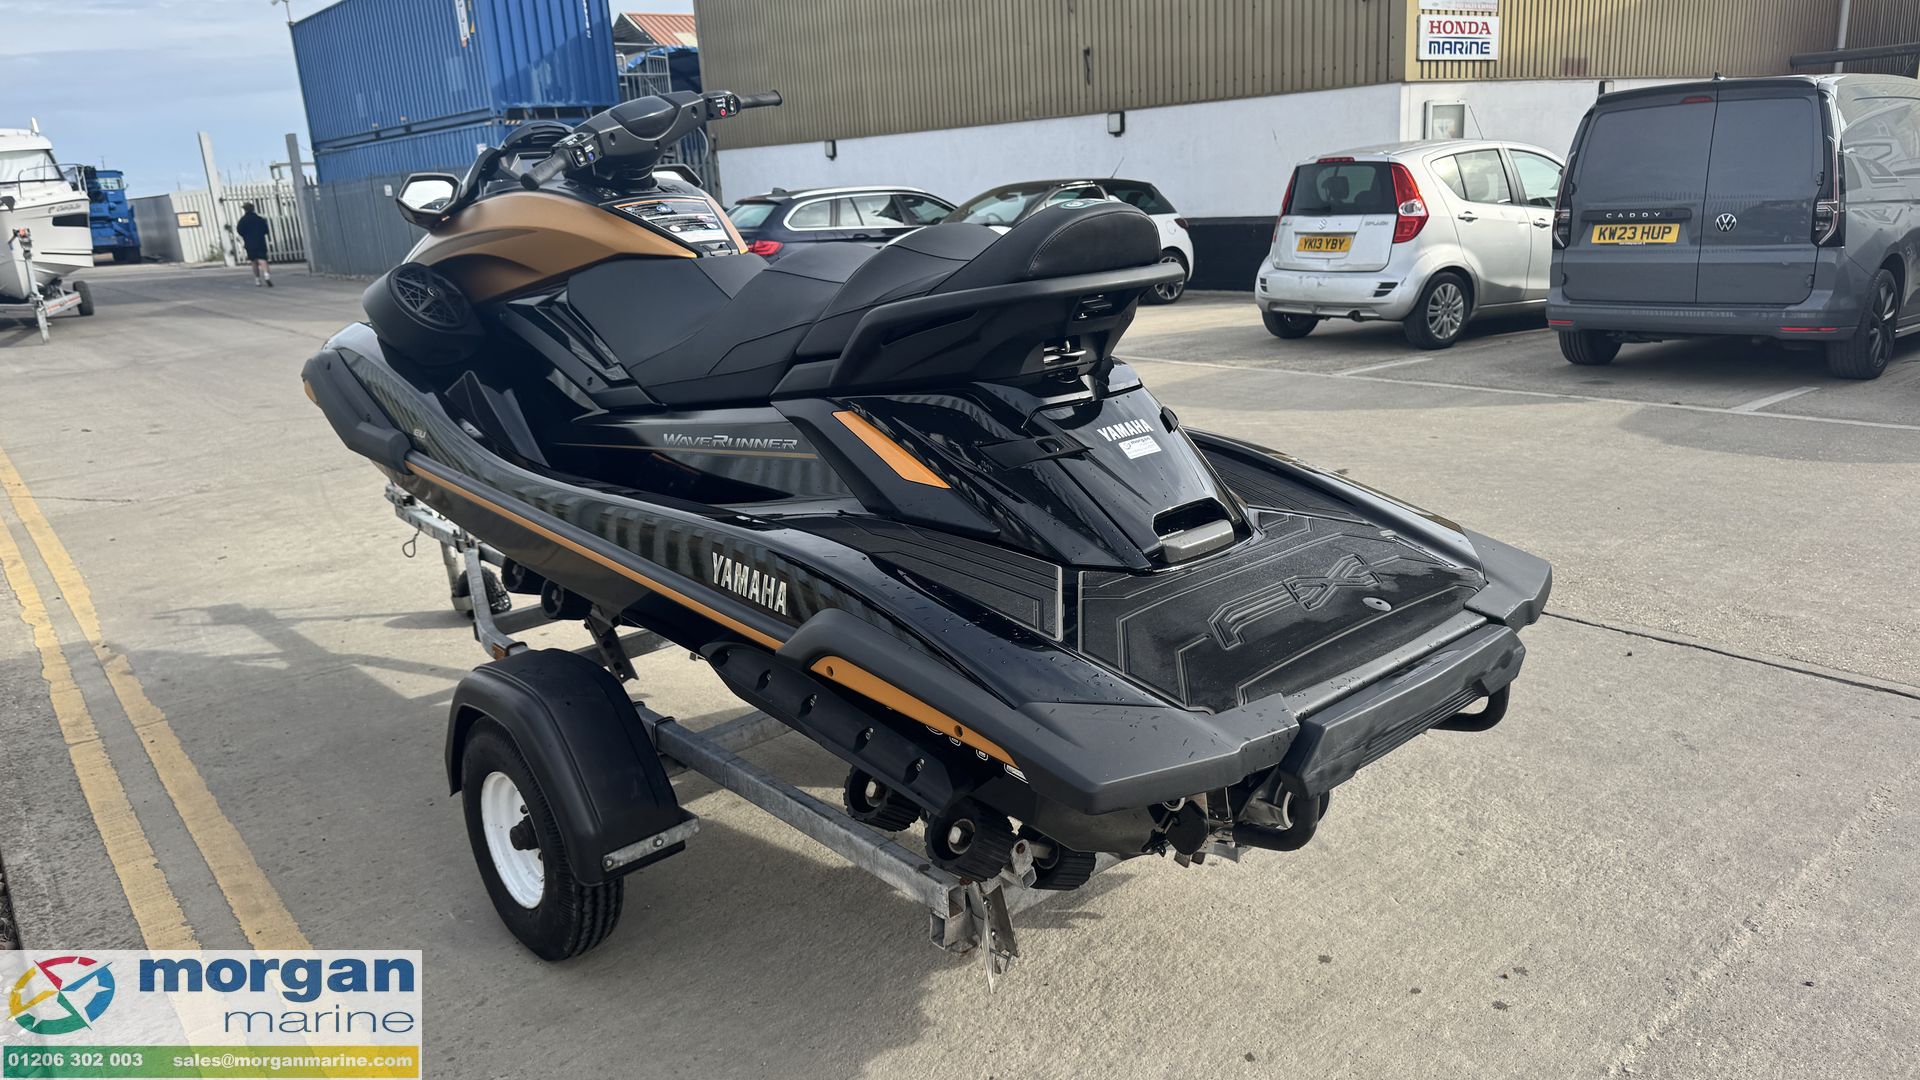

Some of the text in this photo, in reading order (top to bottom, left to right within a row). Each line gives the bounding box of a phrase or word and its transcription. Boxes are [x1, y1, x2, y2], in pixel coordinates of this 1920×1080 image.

[1428, 20, 1491, 34] HONDA
[1598, 225, 1672, 240] KW23 HUP
[1303, 239, 1345, 249] YK13 YBY
[1097, 419, 1153, 441] YAMAHA
[712, 551, 787, 616] YAMAHA
